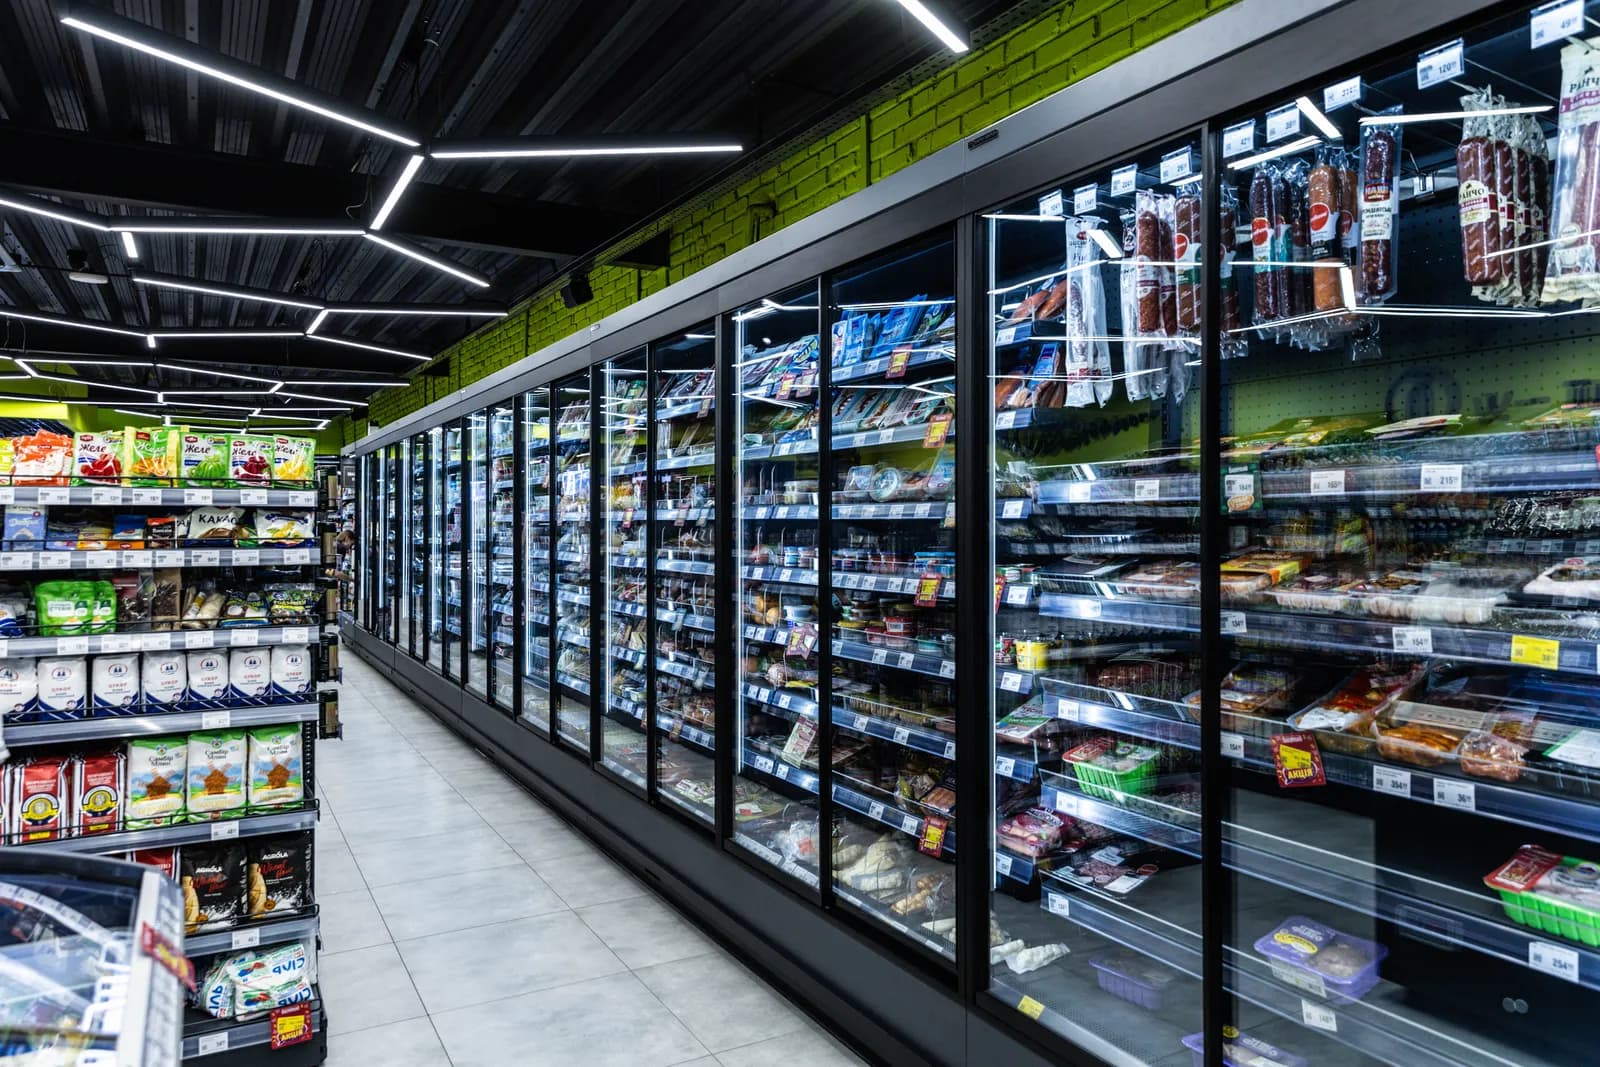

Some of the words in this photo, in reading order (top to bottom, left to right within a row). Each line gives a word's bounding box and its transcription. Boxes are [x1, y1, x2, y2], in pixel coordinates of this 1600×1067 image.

[1569, 77, 1600, 93] РАНЧ
[79, 443, 107, 454] Желе
[185, 443, 211, 454] Желе
[1287, 768, 1314, 779] АКЦІЯ
